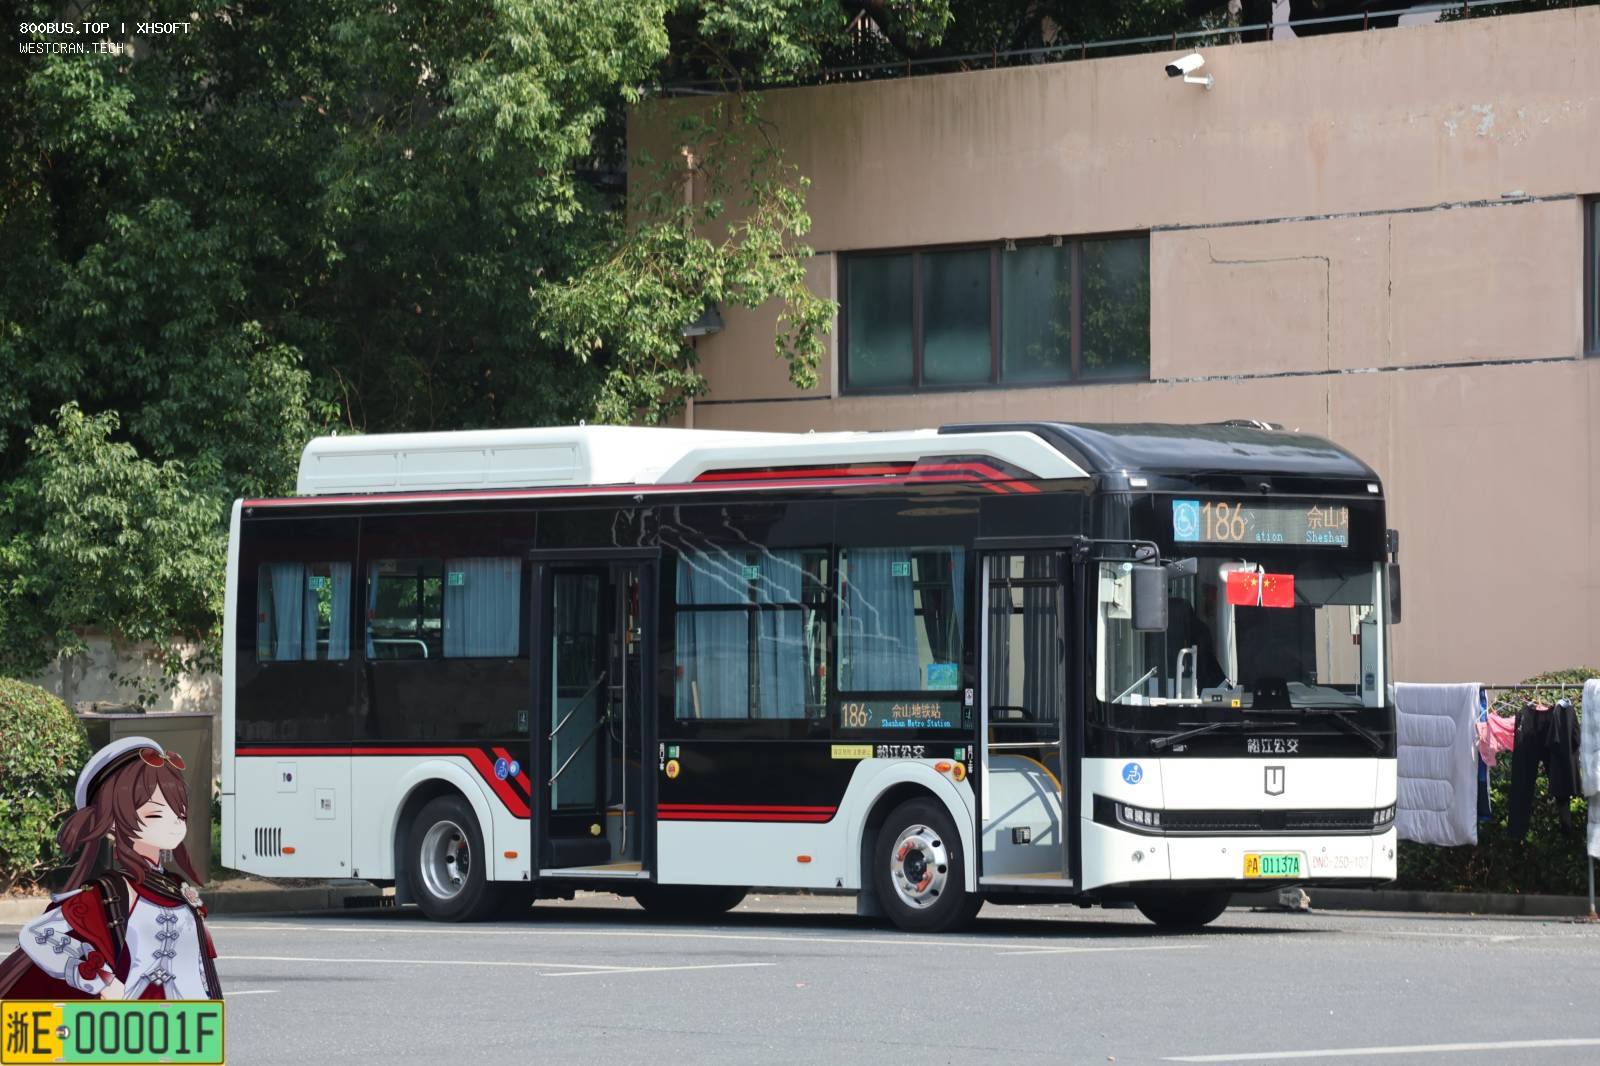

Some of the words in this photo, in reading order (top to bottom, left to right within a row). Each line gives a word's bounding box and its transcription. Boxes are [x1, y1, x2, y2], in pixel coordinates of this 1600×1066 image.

[1202, 502, 1245, 541] 186
[1305, 530, 1346, 543] Sheshan
[842, 703, 867, 728] 186
[891, 703, 942, 719] 佘山地铁站
[907, 718, 925, 728] Metro
[926, 718, 952, 728] Station
[1262, 857, 1300, 874] 01137A
